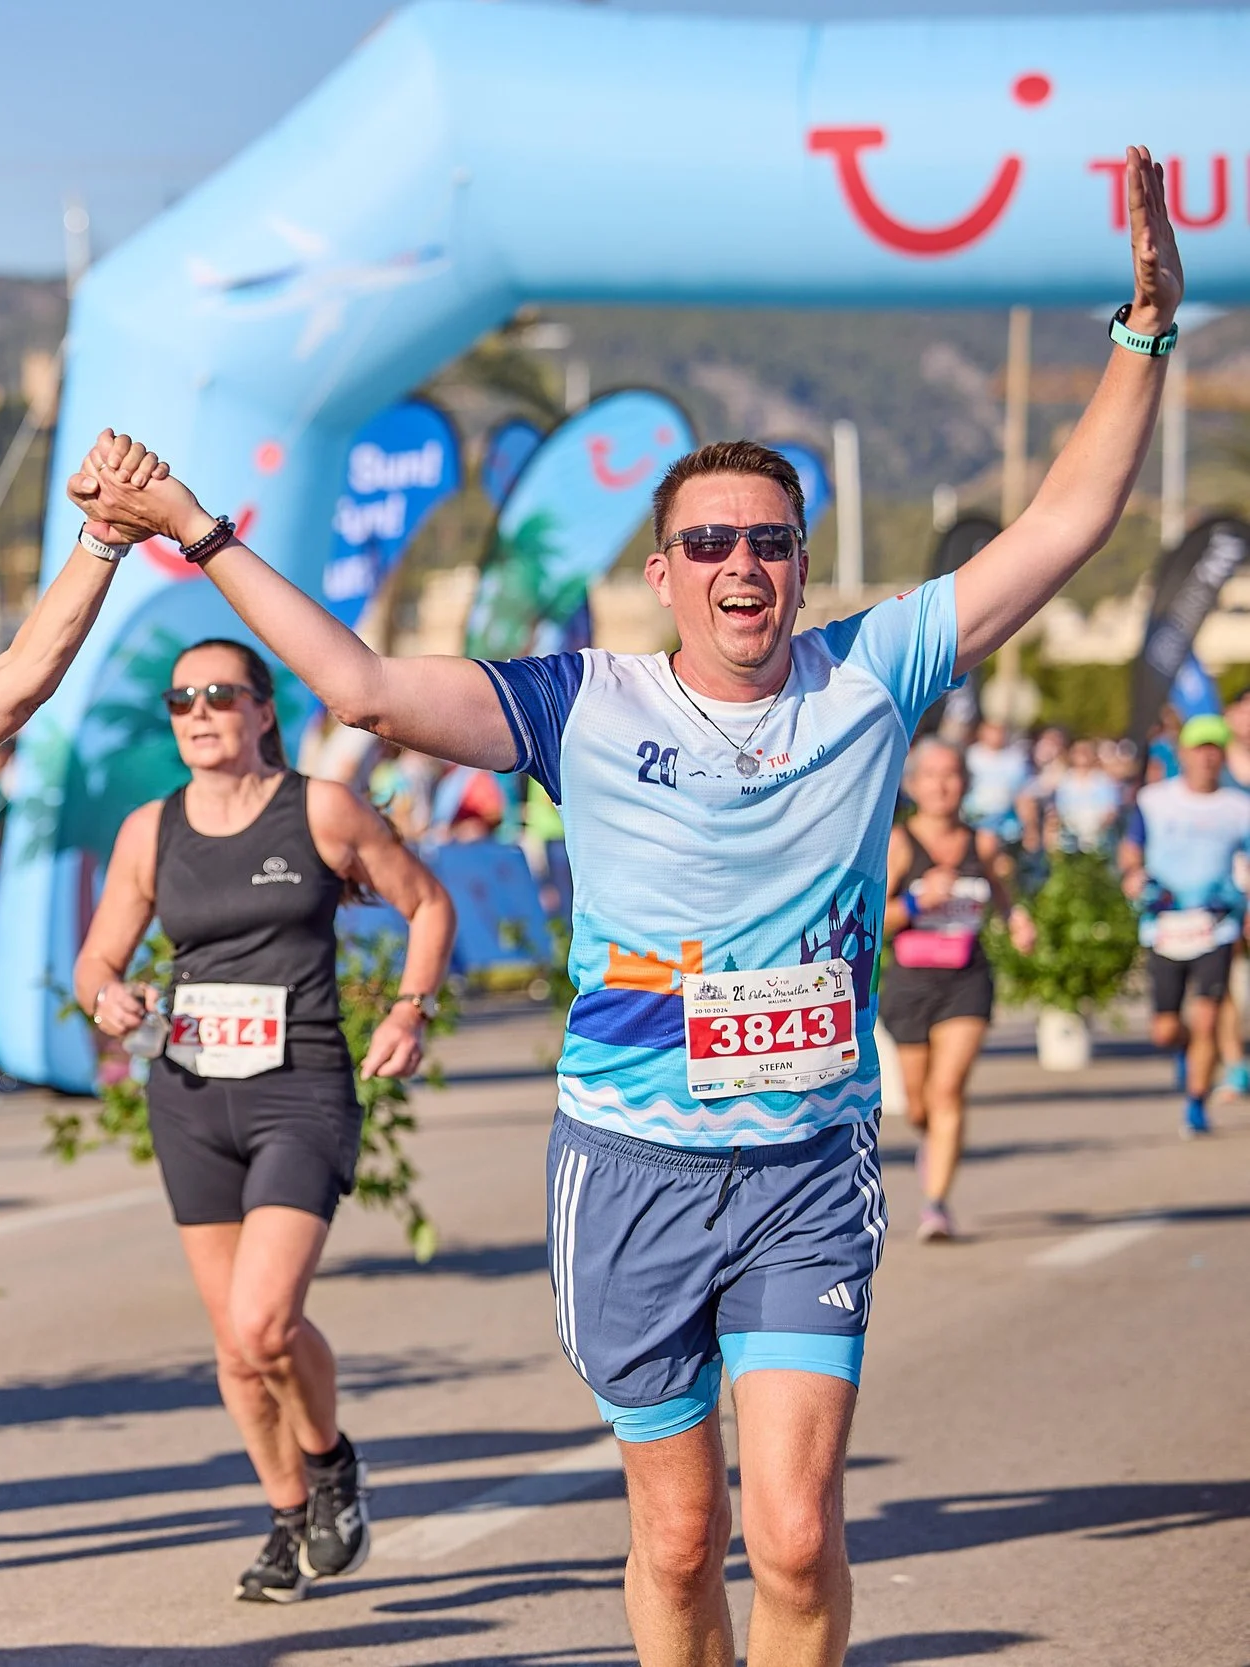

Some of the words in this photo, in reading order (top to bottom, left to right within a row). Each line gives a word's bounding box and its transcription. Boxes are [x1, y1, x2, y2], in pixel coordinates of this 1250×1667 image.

[1088, 153, 1250, 232] TU
[636, 740, 680, 791] 20
[767, 752, 791, 769] TUI
[748, 990, 773, 1001] Palma
[773, 984, 810, 998] Marathon
[178, 1016, 269, 1046] 2614
[709, 1006, 836, 1055] 3843
[759, 1061, 793, 1072] STEFAN
